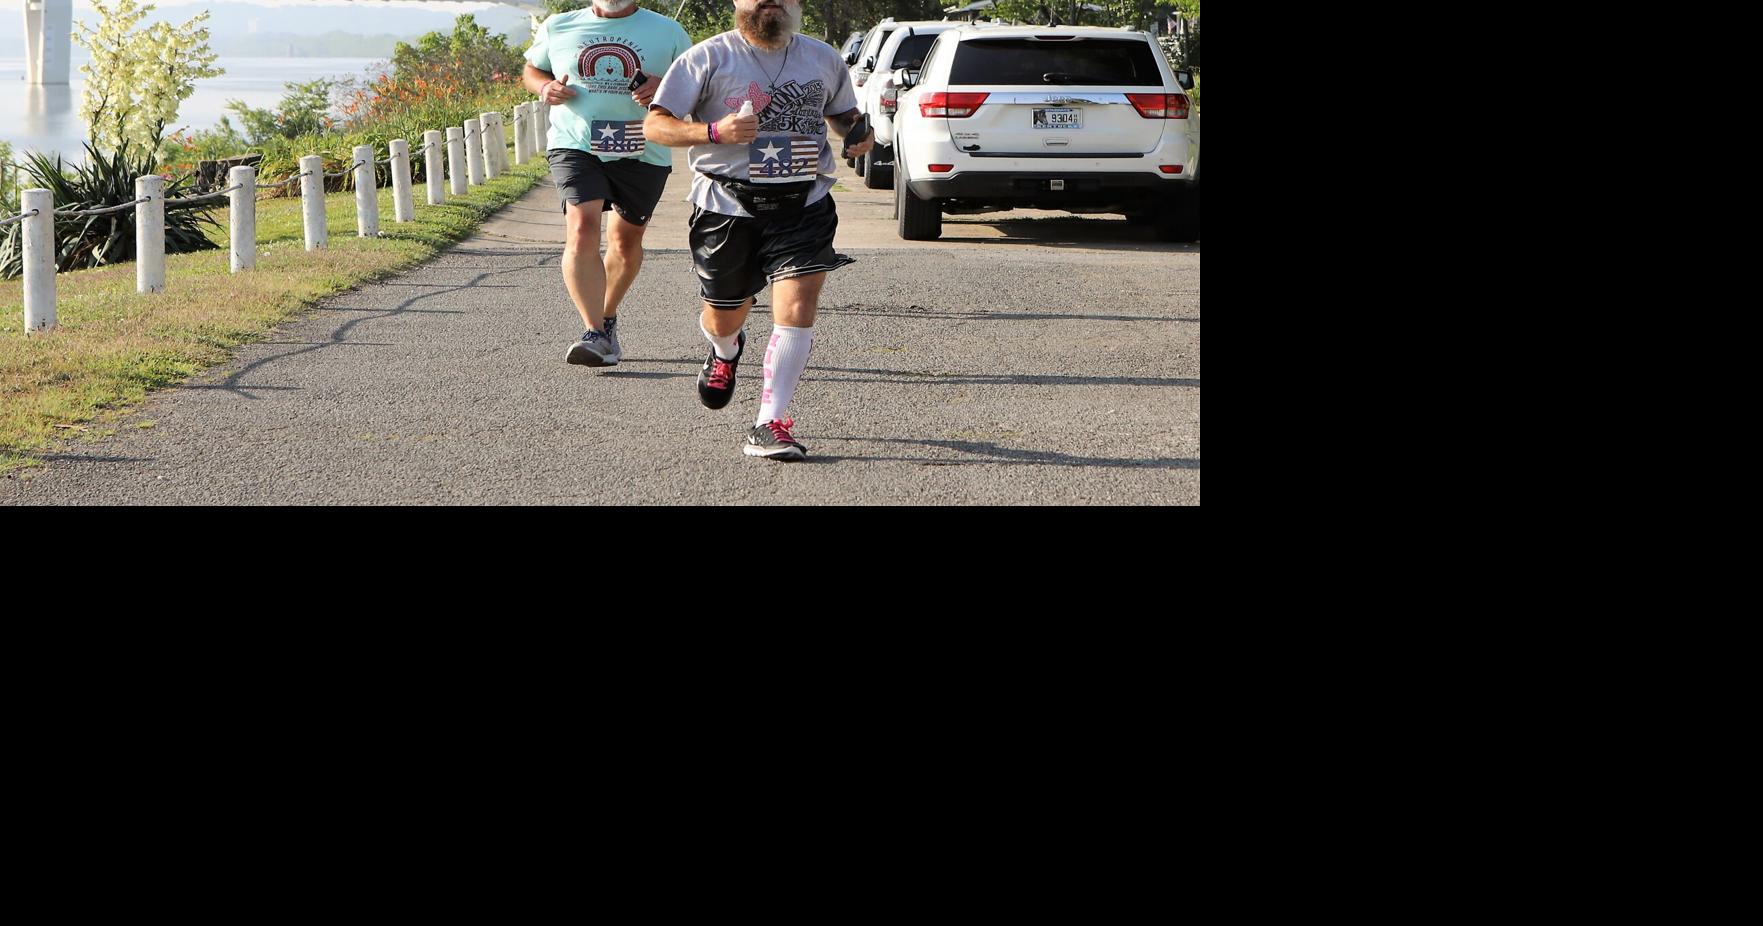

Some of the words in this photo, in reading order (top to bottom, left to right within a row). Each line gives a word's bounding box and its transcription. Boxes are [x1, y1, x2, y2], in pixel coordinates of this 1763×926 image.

[802, 82, 823, 95] 2013
[778, 115, 802, 132] 5K
[1051, 113, 1073, 123] 9304
[759, 158, 809, 178] 482
